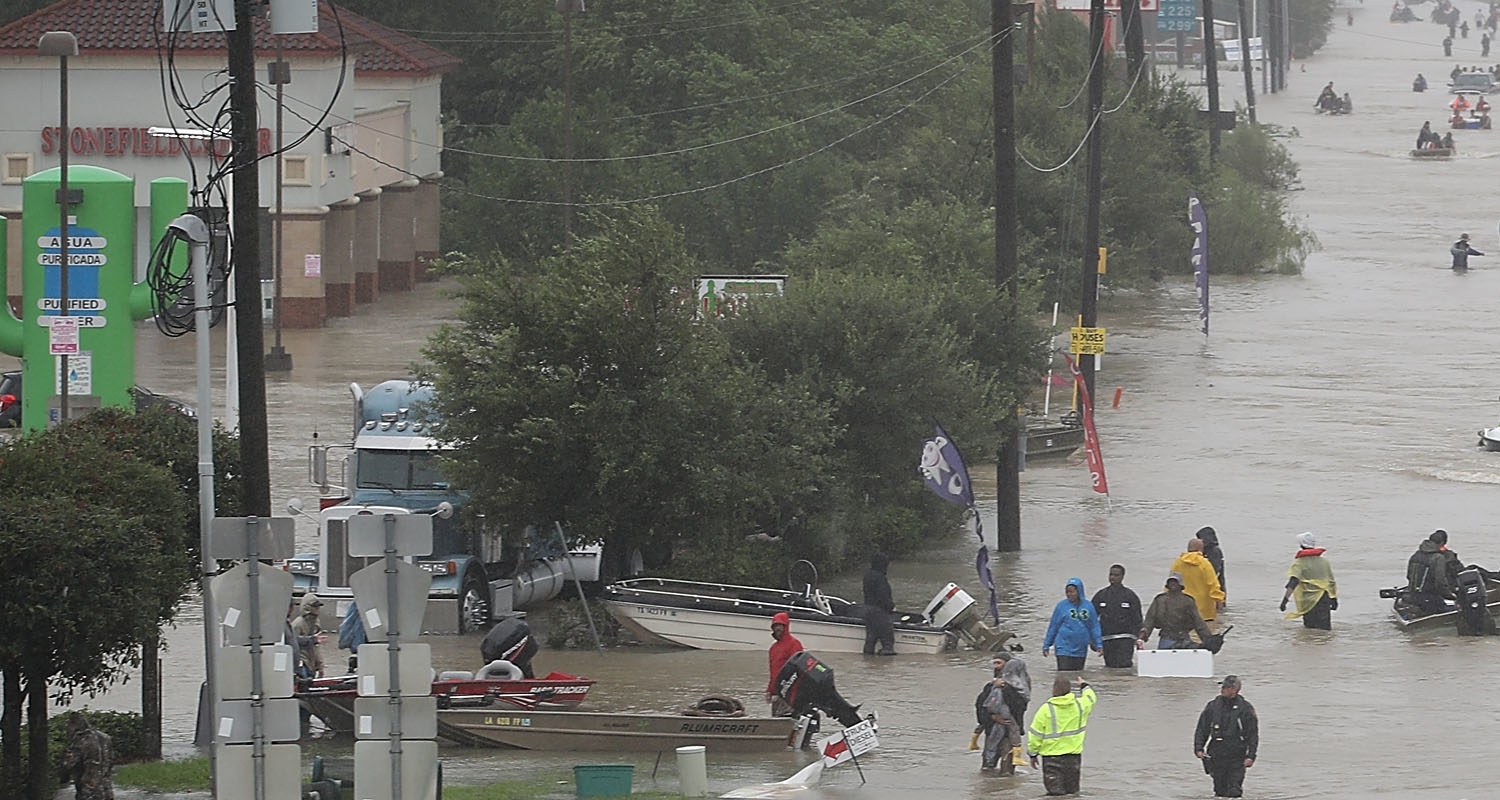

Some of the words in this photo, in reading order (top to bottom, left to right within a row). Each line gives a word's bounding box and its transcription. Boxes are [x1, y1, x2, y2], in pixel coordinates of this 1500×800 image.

[50, 237, 93, 248] AUA
[42, 255, 101, 265] PURFICADA
[44, 299, 99, 309] PUIFIED
[553, 685, 591, 694] TRACKER
[680, 723, 759, 733] ALUMACRAFT
[850, 731, 873, 747] DIESEL
